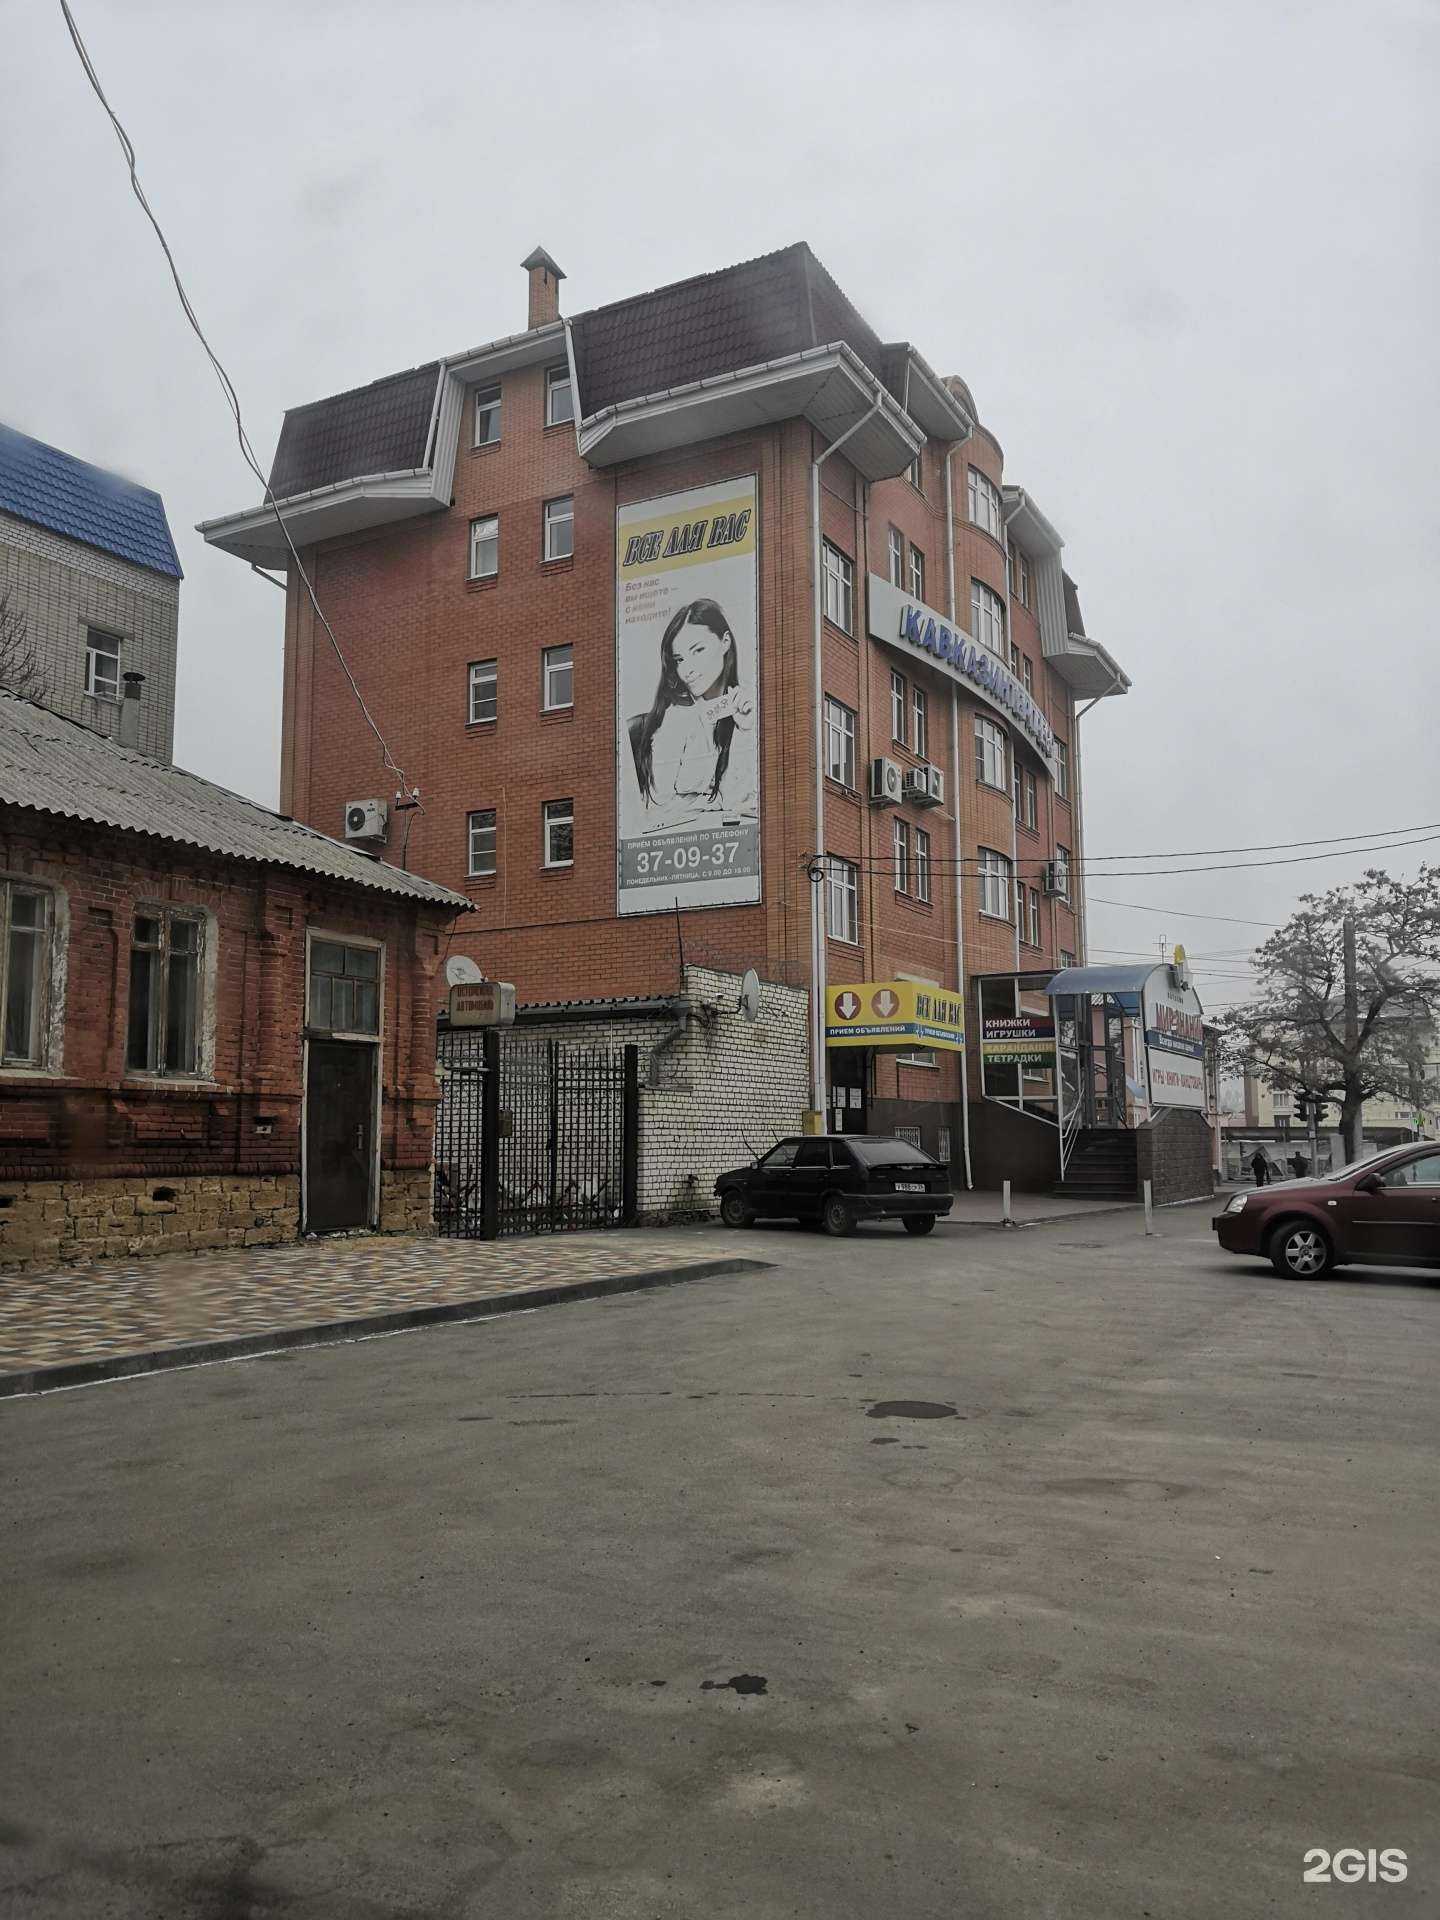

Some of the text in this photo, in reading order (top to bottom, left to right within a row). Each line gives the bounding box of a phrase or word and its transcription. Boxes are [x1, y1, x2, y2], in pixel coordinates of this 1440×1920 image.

[623, 509, 751, 566] ВСЕ ДЛЯ ВАС
[699, 833, 710, 841] ПО
[712, 829, 749, 840] ТЕЛЕФОНУ
[637, 842, 740, 873] 37-09-37
[985, 1019, 1031, 1028] КНИЖКИ
[830, 1024, 906, 1035] ПРИЕМ ОБЪЯВЛЕНИЙ
[986, 1029, 1036, 1038] ИГРУШКИ
[987, 1054, 1042, 1063] ТЕТРАДКИ
